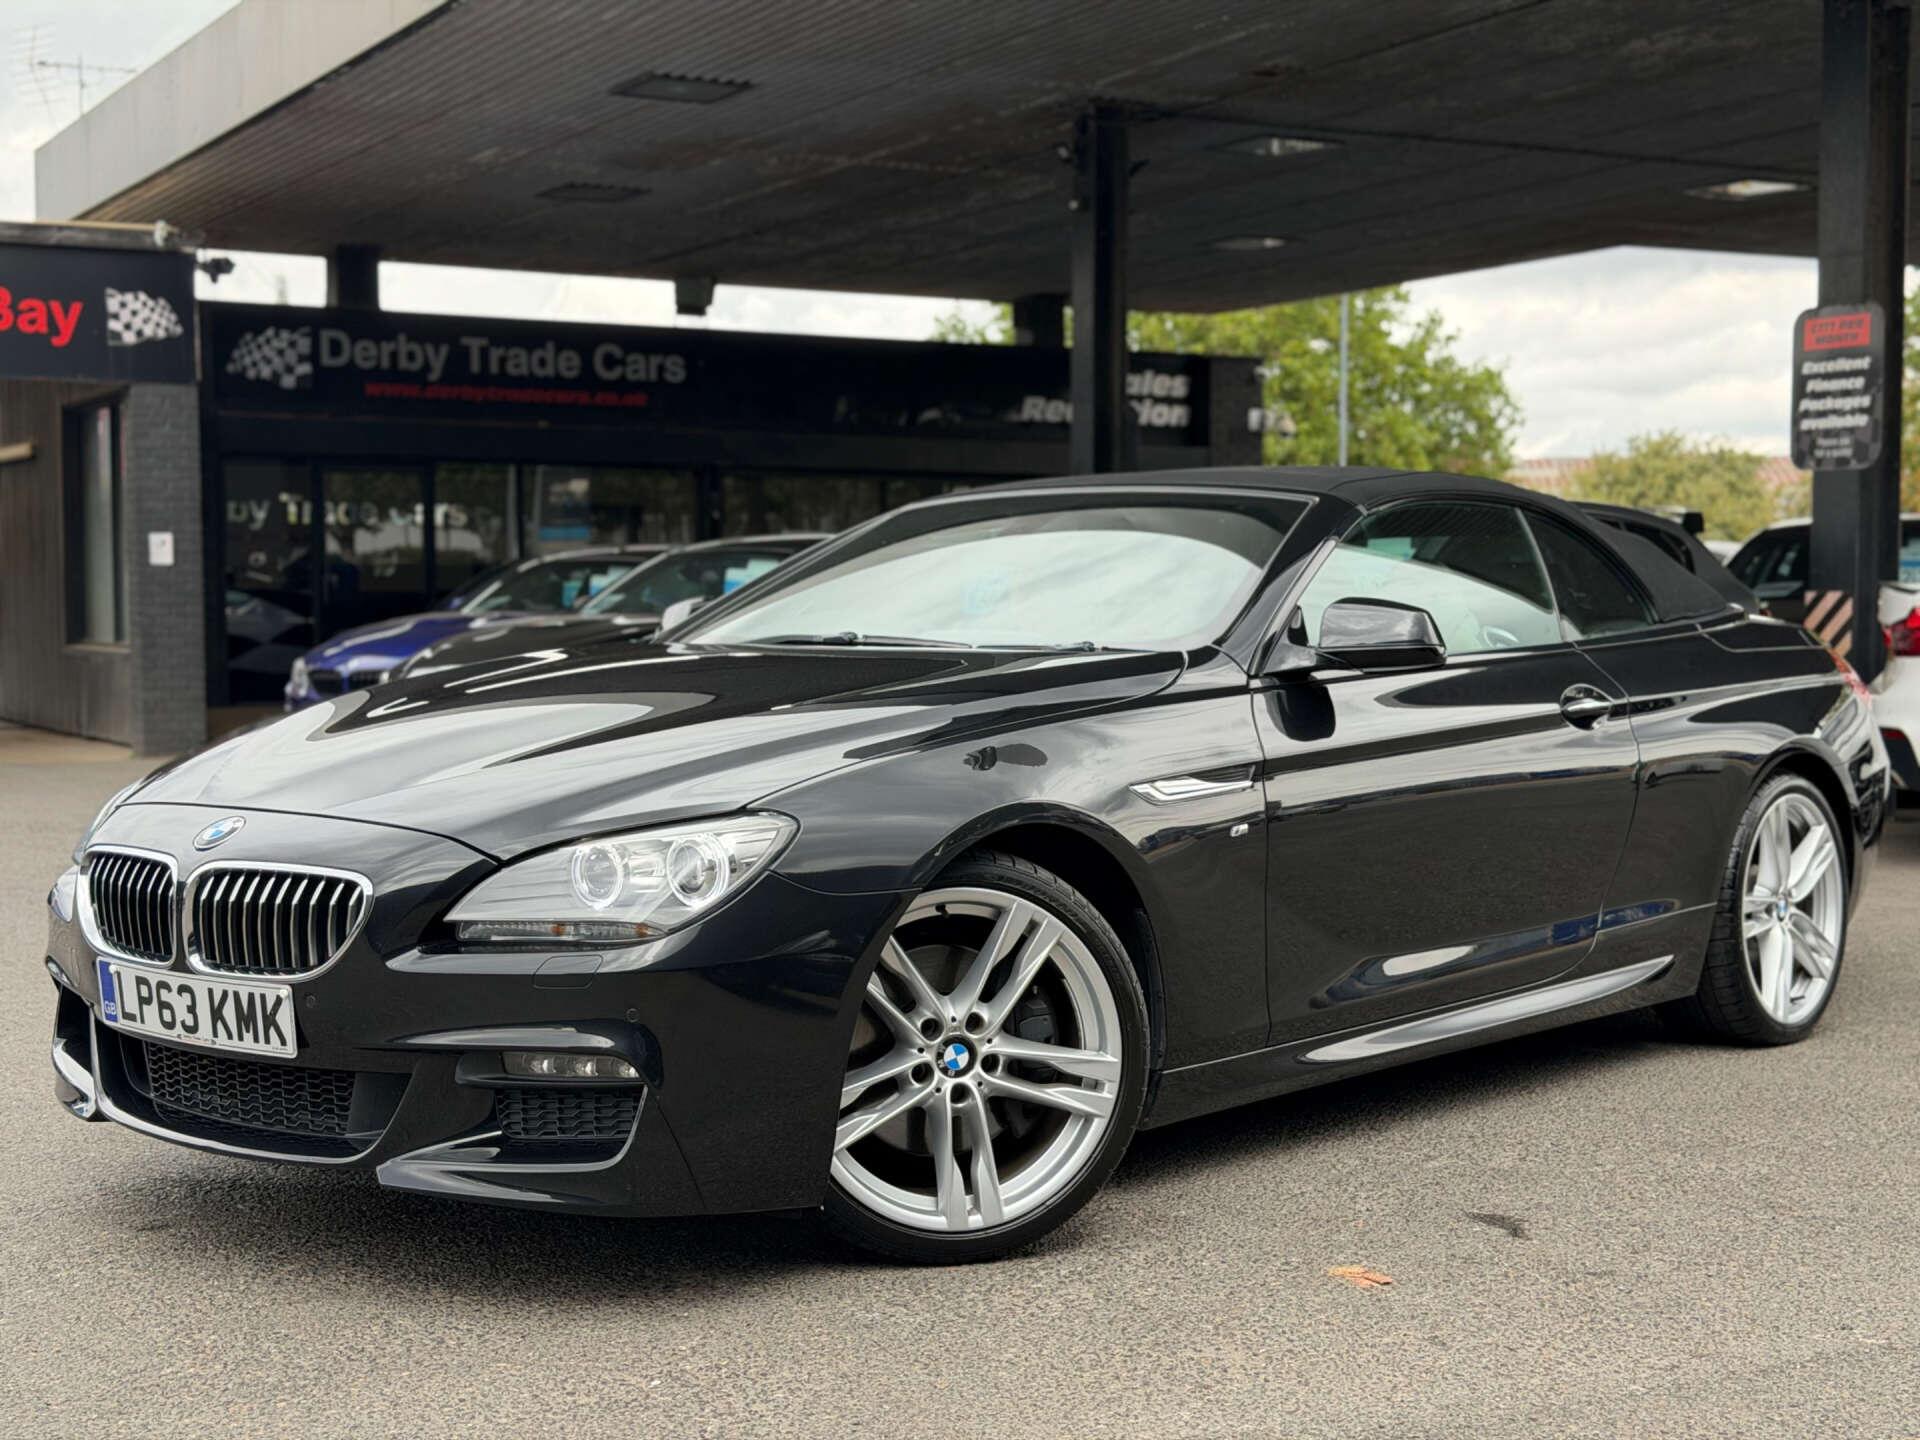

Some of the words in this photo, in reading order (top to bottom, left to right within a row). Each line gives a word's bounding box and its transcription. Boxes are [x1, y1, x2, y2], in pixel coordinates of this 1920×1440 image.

[0, 286, 84, 347] Bay
[319, 329, 449, 382] Derby
[460, 336, 581, 378] Trade
[593, 343, 686, 384] Cars
[1802, 357, 1872, 375] Excellent
[1125, 370, 1189, 397] ales
[1806, 376, 1866, 393] Finance
[1798, 395, 1872, 412] Packages
[104, 1000, 117, 1015] GB
[115, 970, 200, 1035] LP63
[207, 987, 288, 1047] KMK
